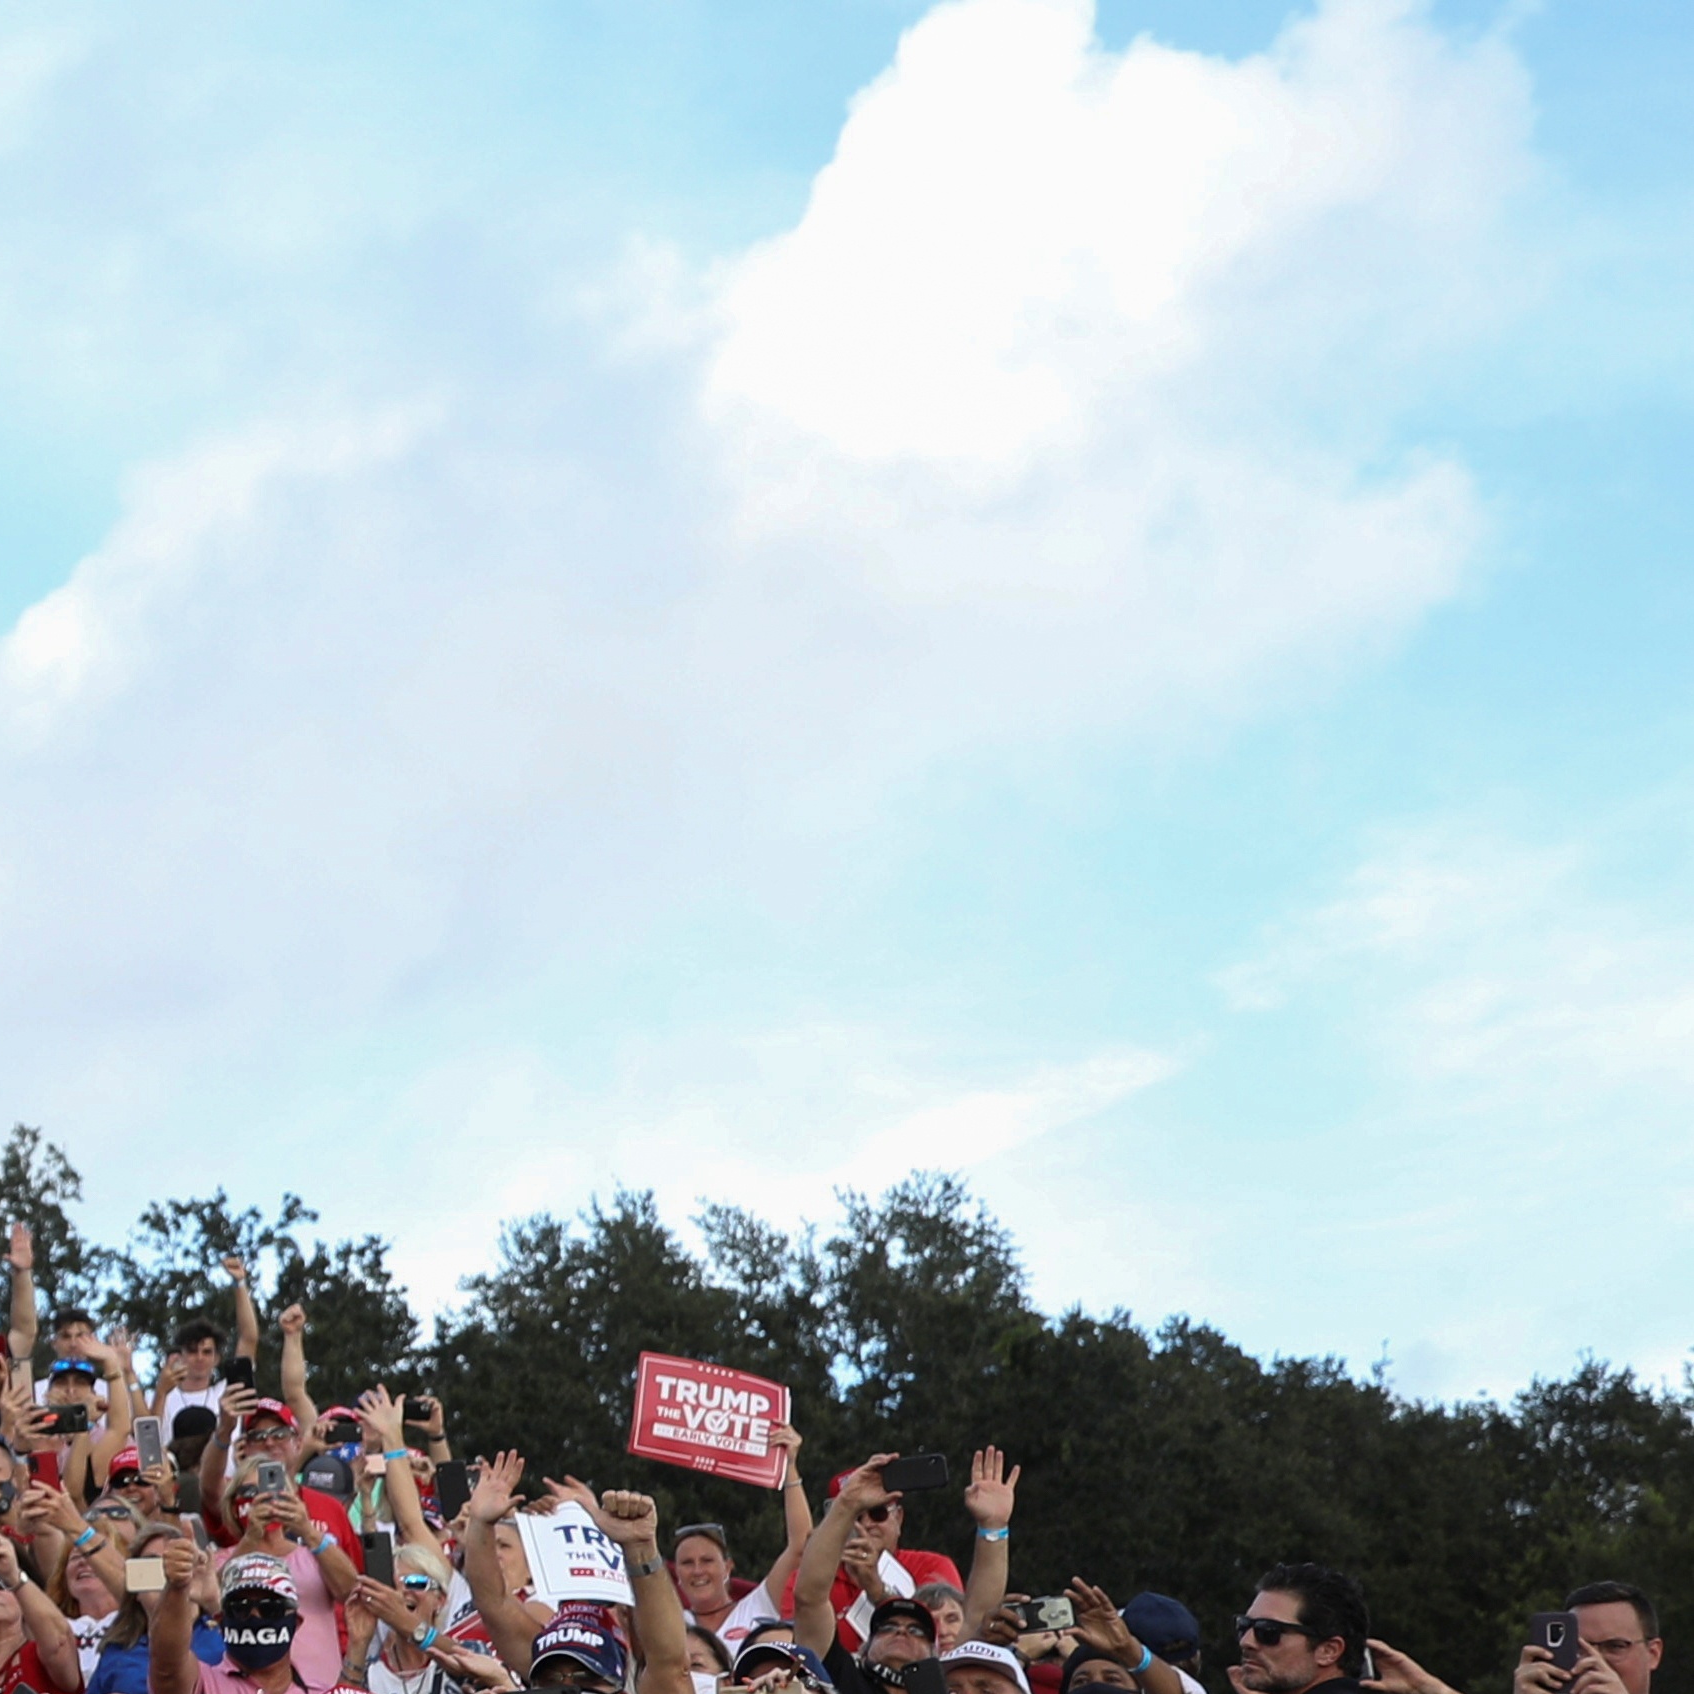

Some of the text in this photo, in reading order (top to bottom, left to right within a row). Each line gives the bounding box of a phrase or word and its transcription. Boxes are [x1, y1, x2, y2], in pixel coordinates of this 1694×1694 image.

[655, 1375, 770, 1416] TRUMP
[657, 1404, 771, 1443] THE VOTE
[673, 1427, 747, 1451] EARLY VOTE
[567, 1552, 595, 1560] THE
[224, 1626, 290, 1645] MAGA
[537, 1629, 604, 1651] TRUMP
